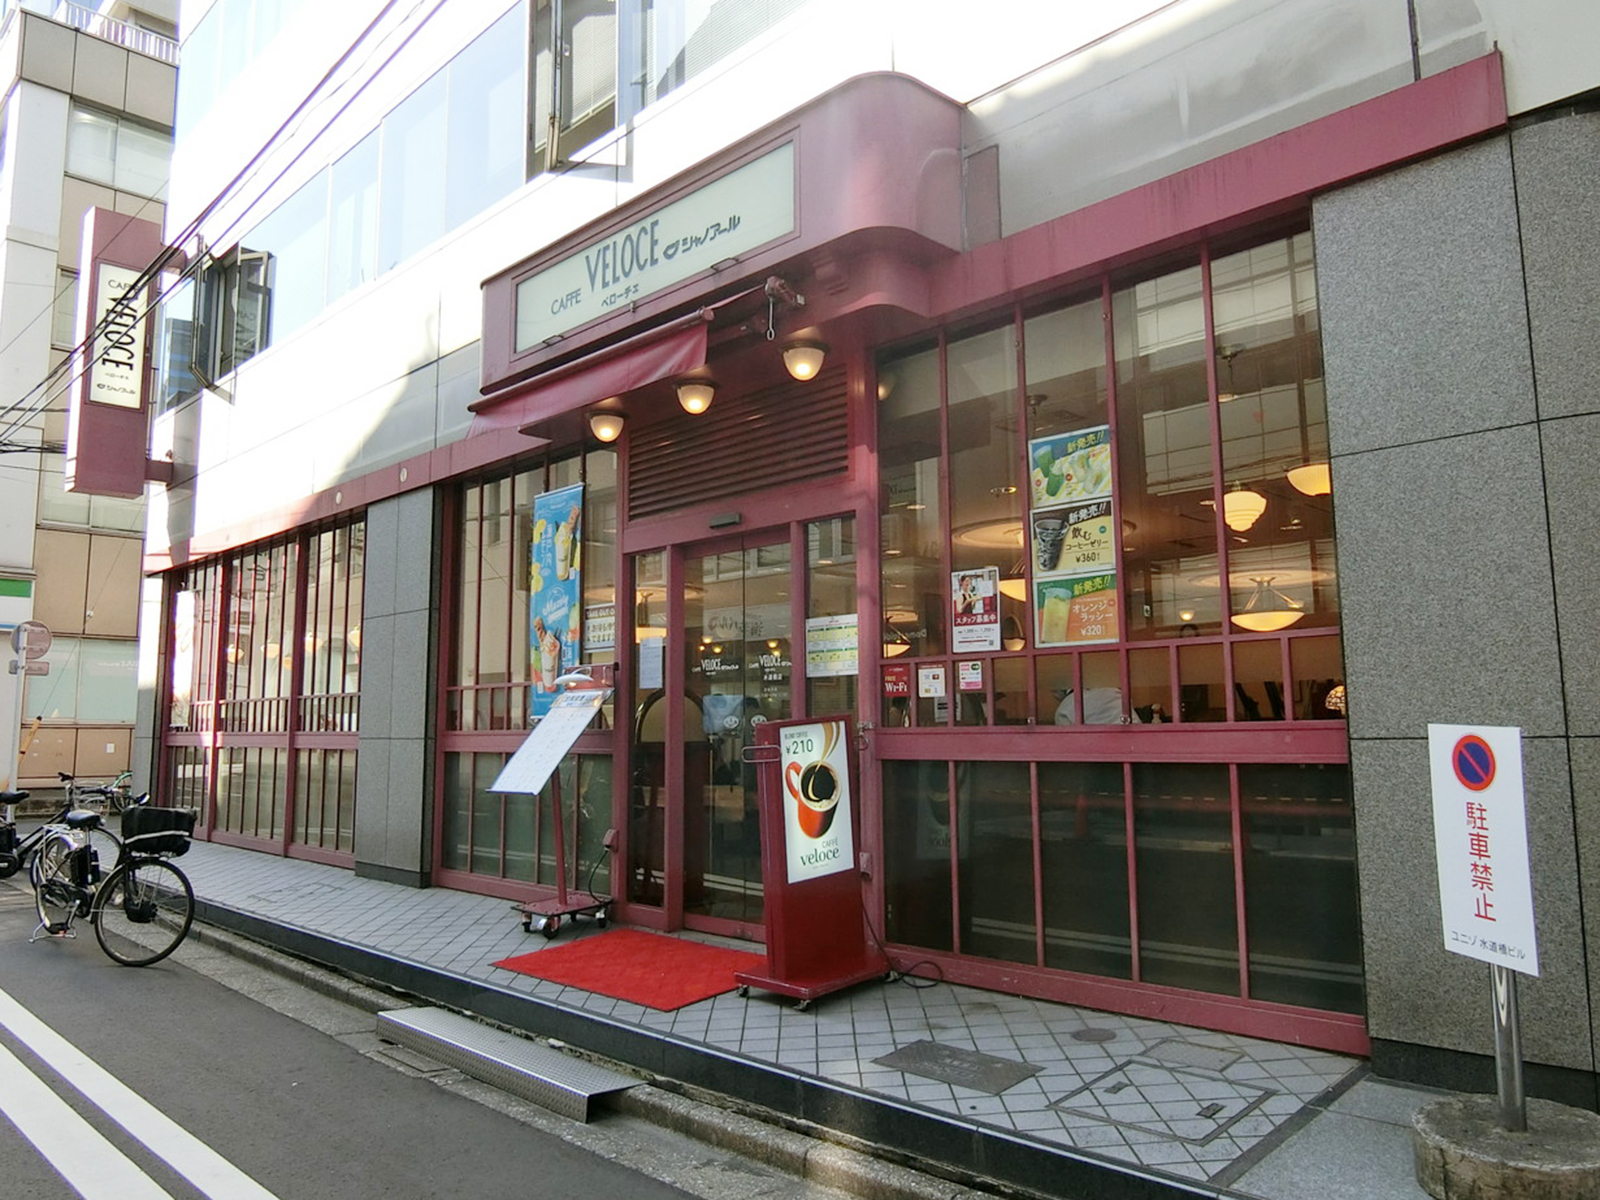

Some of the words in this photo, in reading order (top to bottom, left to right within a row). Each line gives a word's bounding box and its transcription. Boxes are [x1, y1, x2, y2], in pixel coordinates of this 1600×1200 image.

[682, 215, 741, 254] シャノアール
[551, 288, 582, 315] CAFFE
[585, 219, 660, 293] VELOCE
[601, 283, 640, 307] ベローチェ
[102, 297, 138, 371] VELOCE
[1071, 526, 1092, 541] 飲む
[1065, 539, 1109, 551] コーヒーゼリー
[1072, 600, 1108, 614] オレンジ
[1080, 611, 1113, 622] ラッシー
[786, 739, 814, 756] ¥210
[800, 847, 841, 866] veloce
[1466, 801, 1497, 923] 駐車禁止
